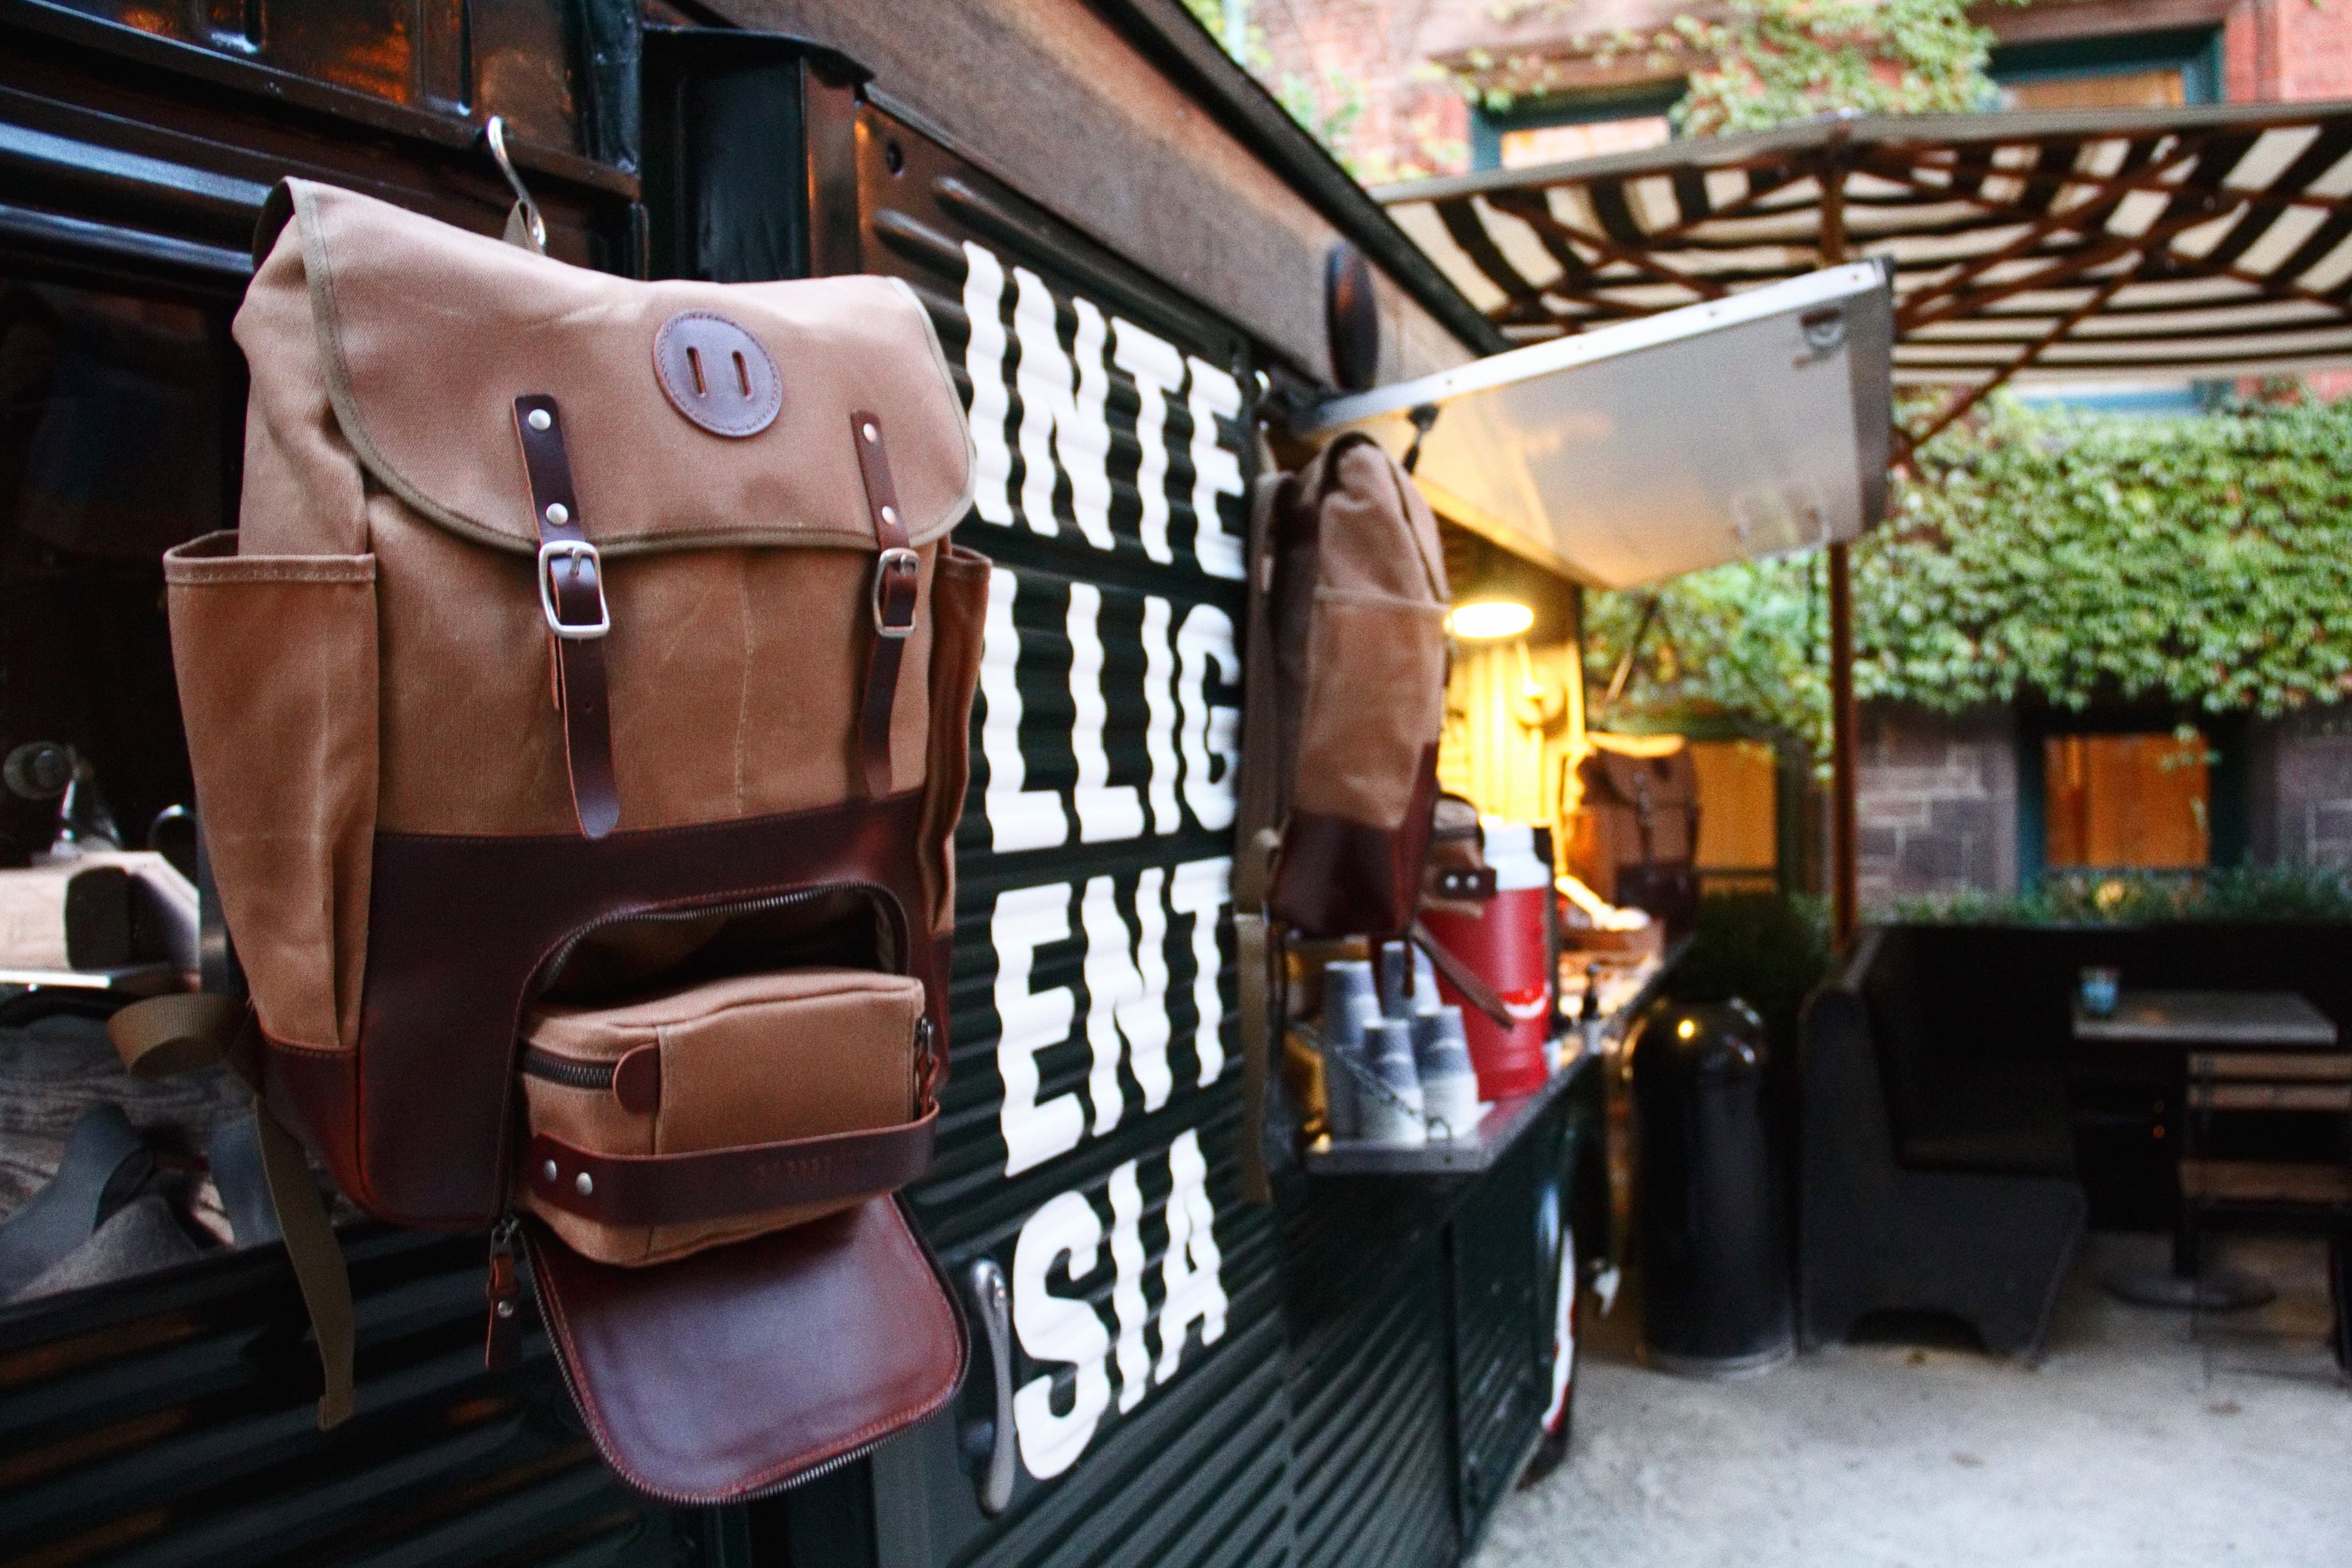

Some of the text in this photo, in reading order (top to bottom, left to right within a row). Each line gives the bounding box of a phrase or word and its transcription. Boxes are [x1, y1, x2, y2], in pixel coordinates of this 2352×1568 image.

[963, 240, 1246, 579] INTE
[979, 566, 1240, 854] LLIG
[991, 857, 1231, 1177] ENT
[1013, 1129, 1229, 1480] SIA
